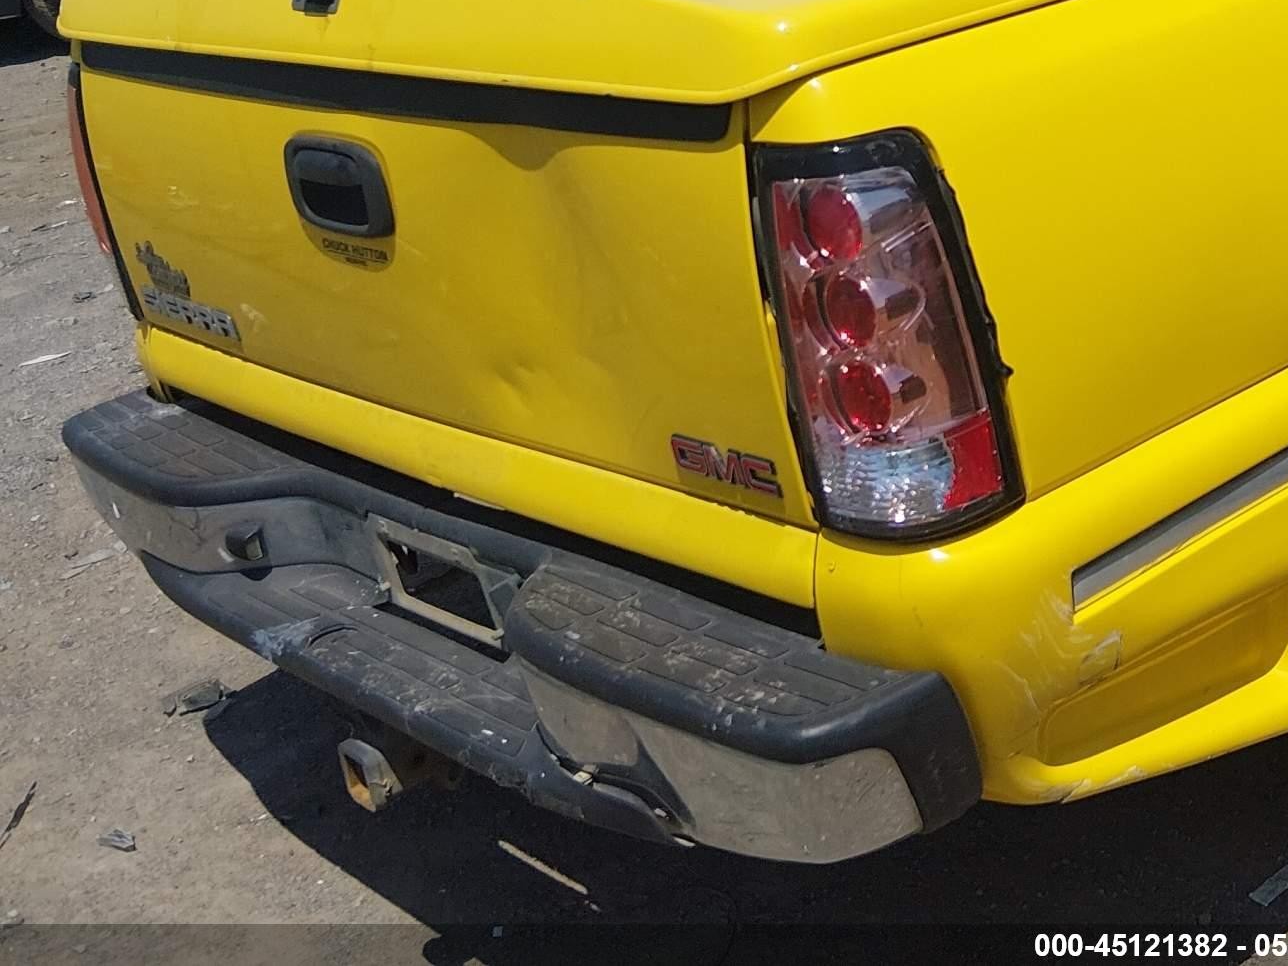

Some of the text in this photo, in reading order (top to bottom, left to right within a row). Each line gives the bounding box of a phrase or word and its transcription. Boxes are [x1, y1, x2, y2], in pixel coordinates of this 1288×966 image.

[351, 241, 389, 262] HUTTON
[142, 287, 242, 343] SIERRA
[671, 433, 784, 499] GMC
